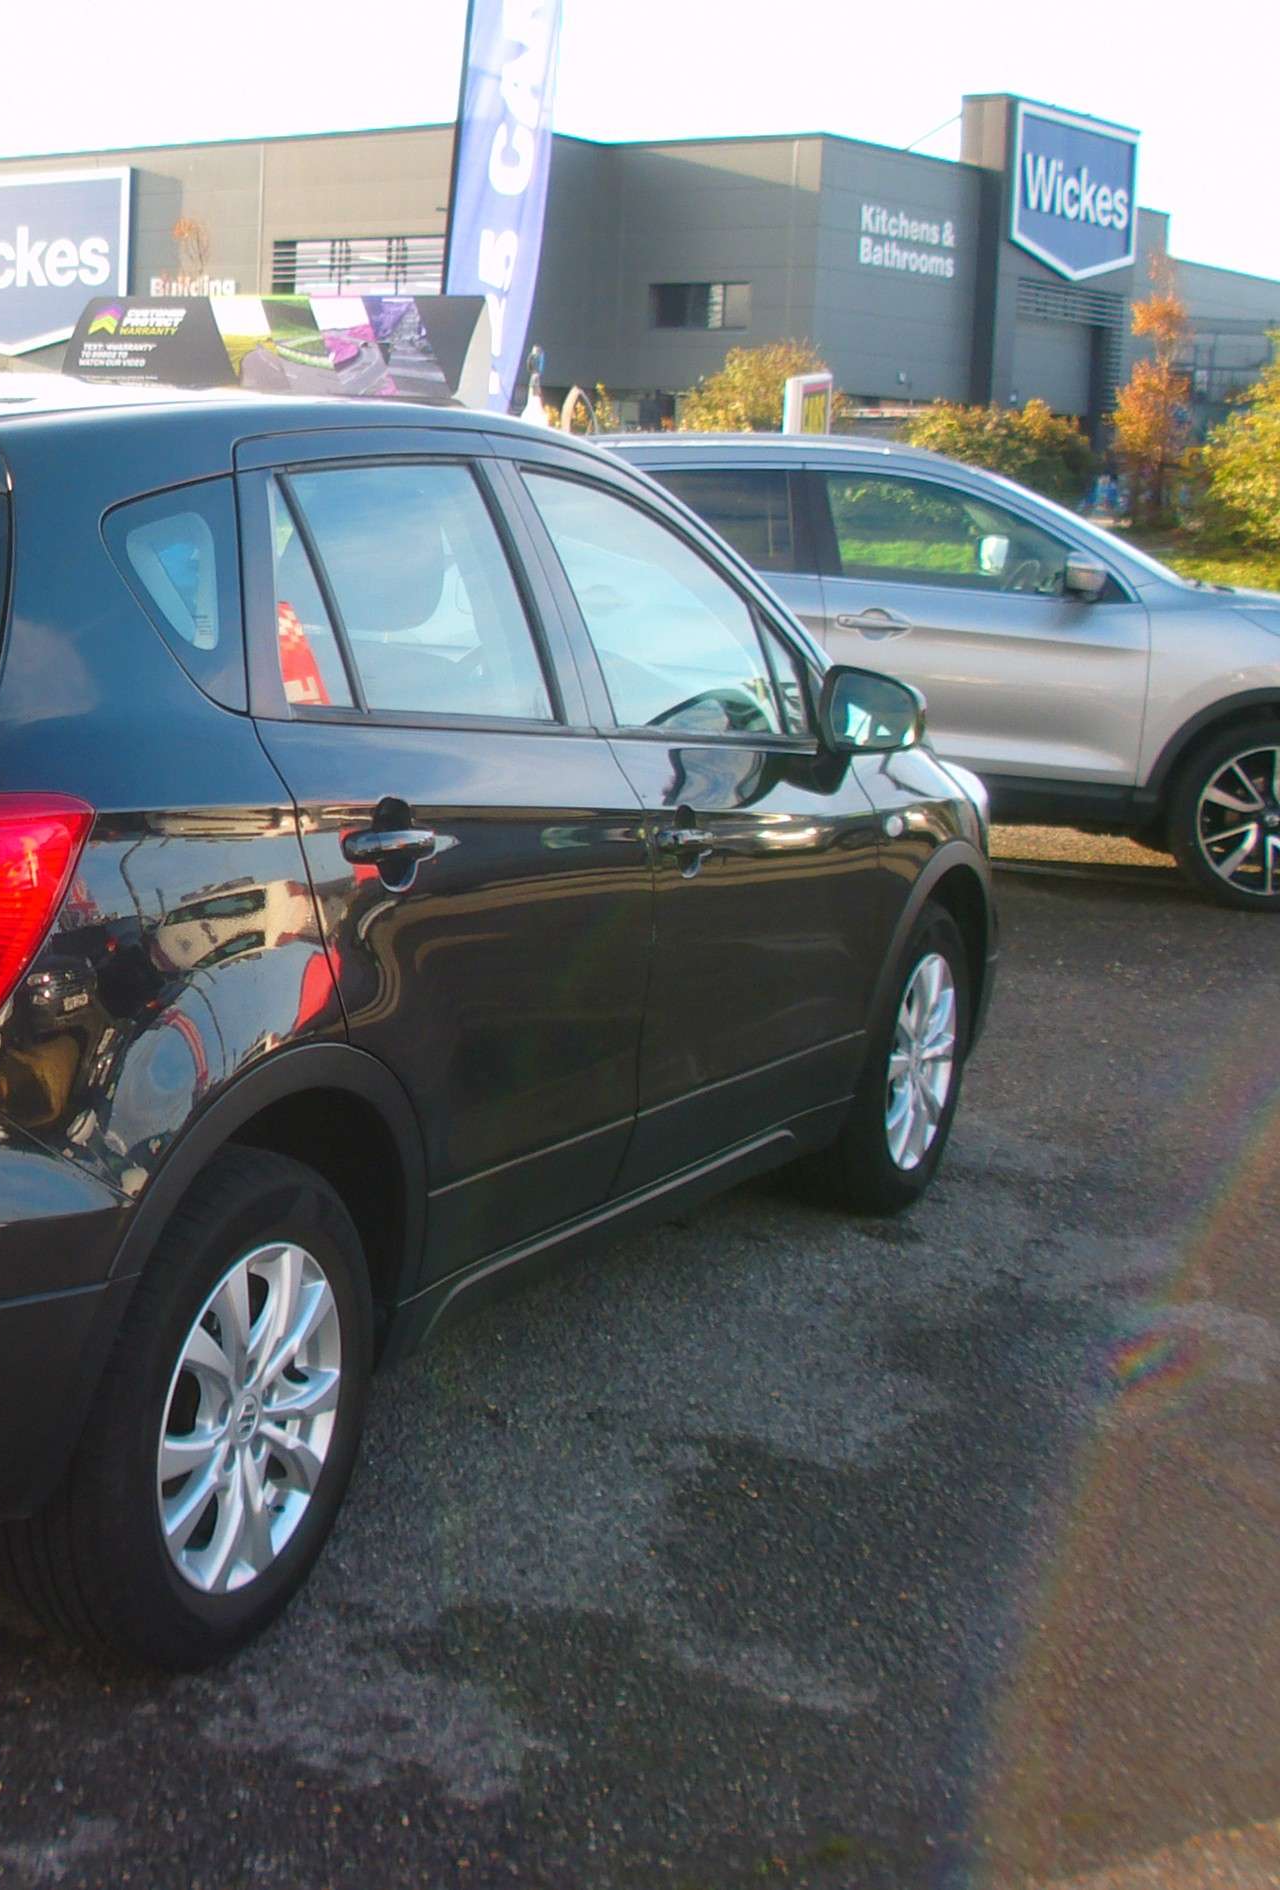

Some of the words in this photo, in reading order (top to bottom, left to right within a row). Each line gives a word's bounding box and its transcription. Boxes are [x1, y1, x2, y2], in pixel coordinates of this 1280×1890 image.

[1025, 152, 1129, 230] Wickes
[861, 204, 940, 245] Kitchens
[943, 220, 955, 247] &
[860, 236, 954, 278] Bathrooms
[119, 326, 178, 336] WARRANTY
